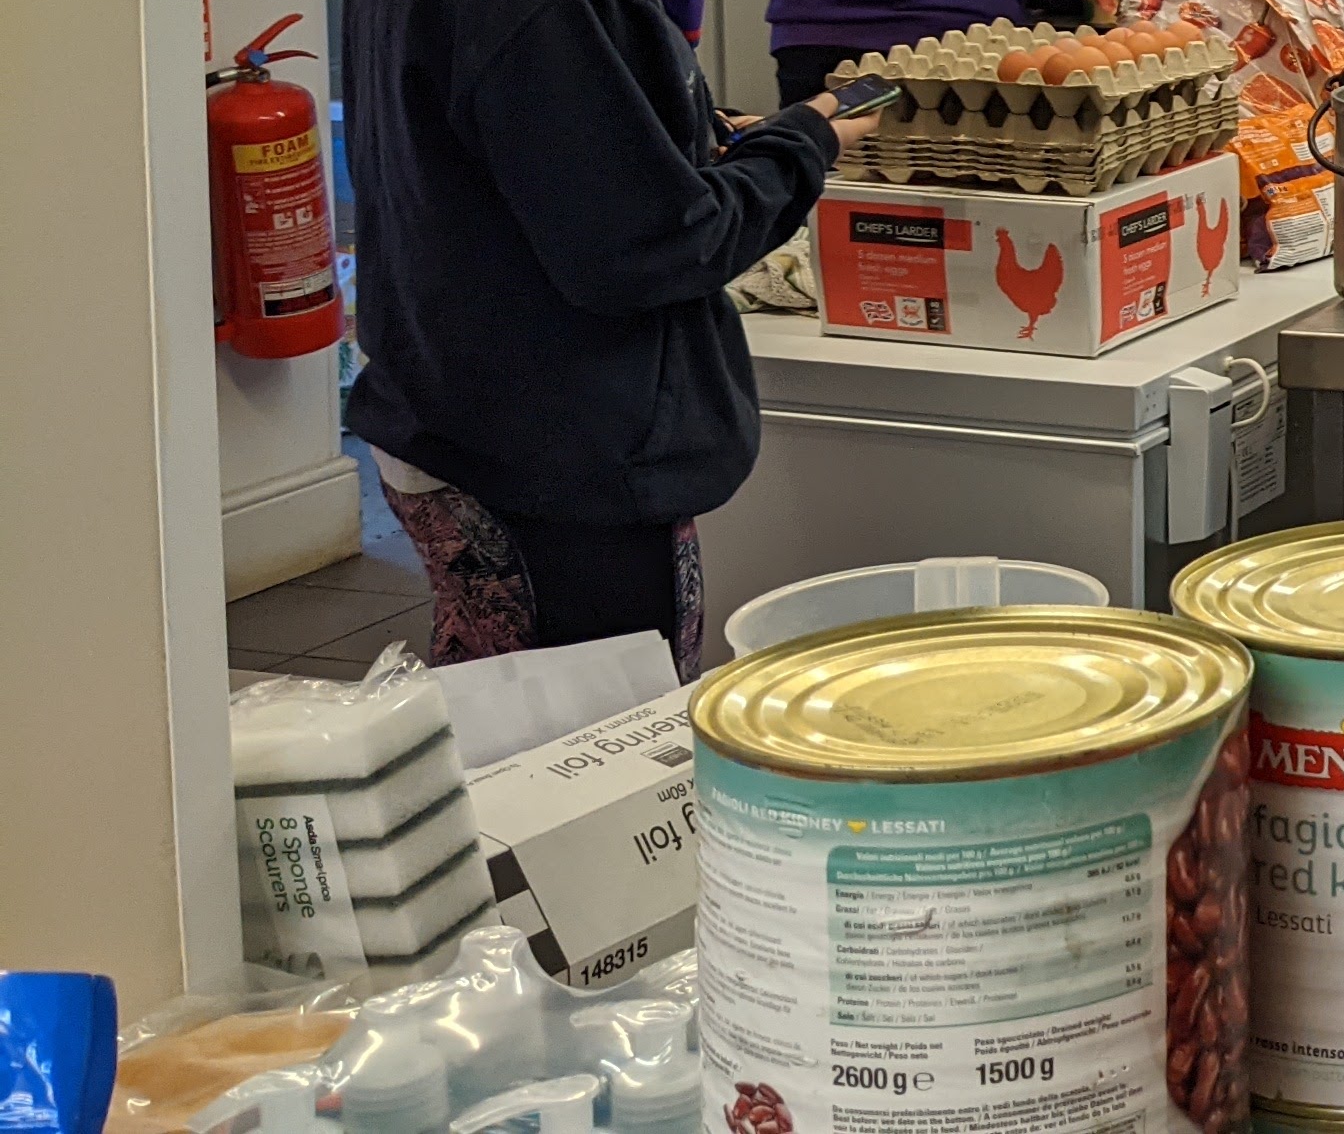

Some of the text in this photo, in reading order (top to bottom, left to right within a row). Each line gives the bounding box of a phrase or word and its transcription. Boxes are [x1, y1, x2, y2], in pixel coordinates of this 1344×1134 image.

[261, 134, 309, 158] FOAM
[855, 221, 939, 238] CHEF'S LARDER
[1121, 211, 1167, 237] CHEF'S LARDER
[593, 710, 691, 755] atering
[605, 707, 657, 731] 300mm
[562, 732, 597, 747] 60m
[546, 752, 605, 780] foil
[657, 783, 688, 803] 60m
[871, 819, 946, 834] LESSATI
[633, 820, 683, 866] foil
[256, 817, 290, 913] Scourers
[279, 817, 316, 919] 8 Sponge
[1253, 858, 1318, 897] red
[1255, 905, 1333, 935] Lessati
[580, 935, 648, 986] 148315
[831, 1064, 888, 1090] 2600
[893, 1072, 907, 1095] g
[975, 1056, 1055, 1086] 1500 g
